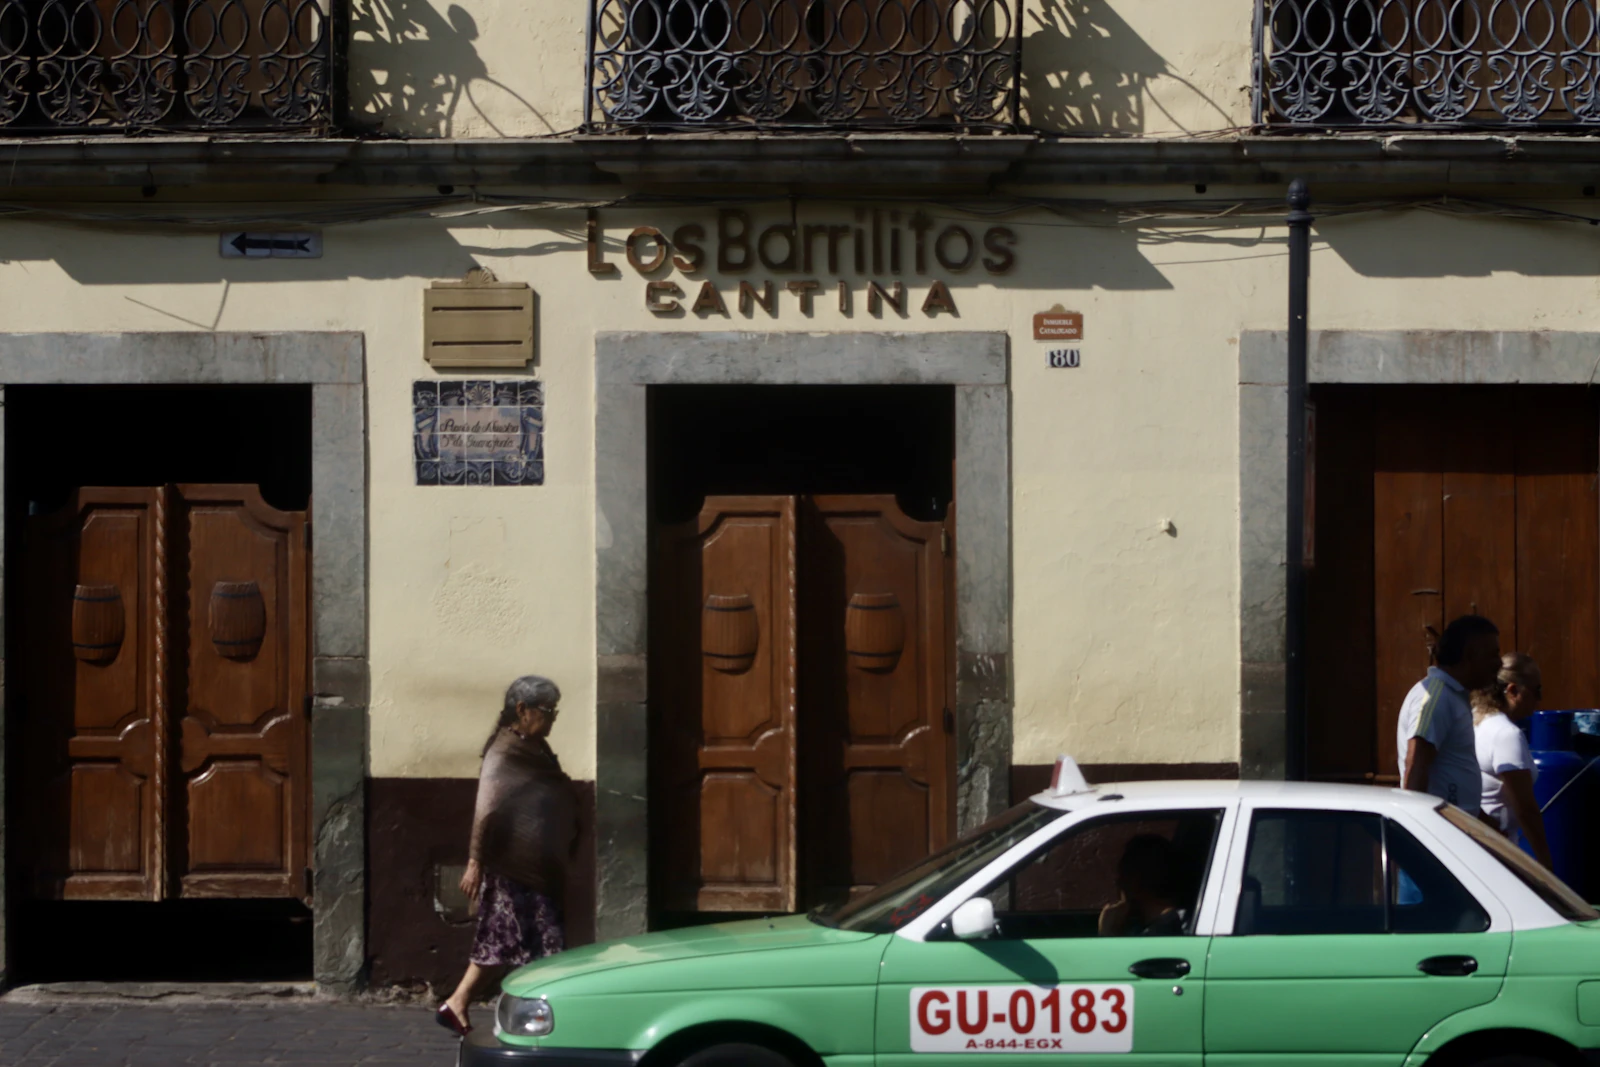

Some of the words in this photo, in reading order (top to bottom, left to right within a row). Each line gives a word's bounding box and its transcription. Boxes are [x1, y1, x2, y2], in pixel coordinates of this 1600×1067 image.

[717, 207, 1019, 276] Barrilitos
[645, 280, 958, 314] CANTINA
[1053, 349, 1078, 367] 80
[917, 988, 1128, 1036] GU-0183
[965, 1038, 1063, 1050] A-844-EGX
